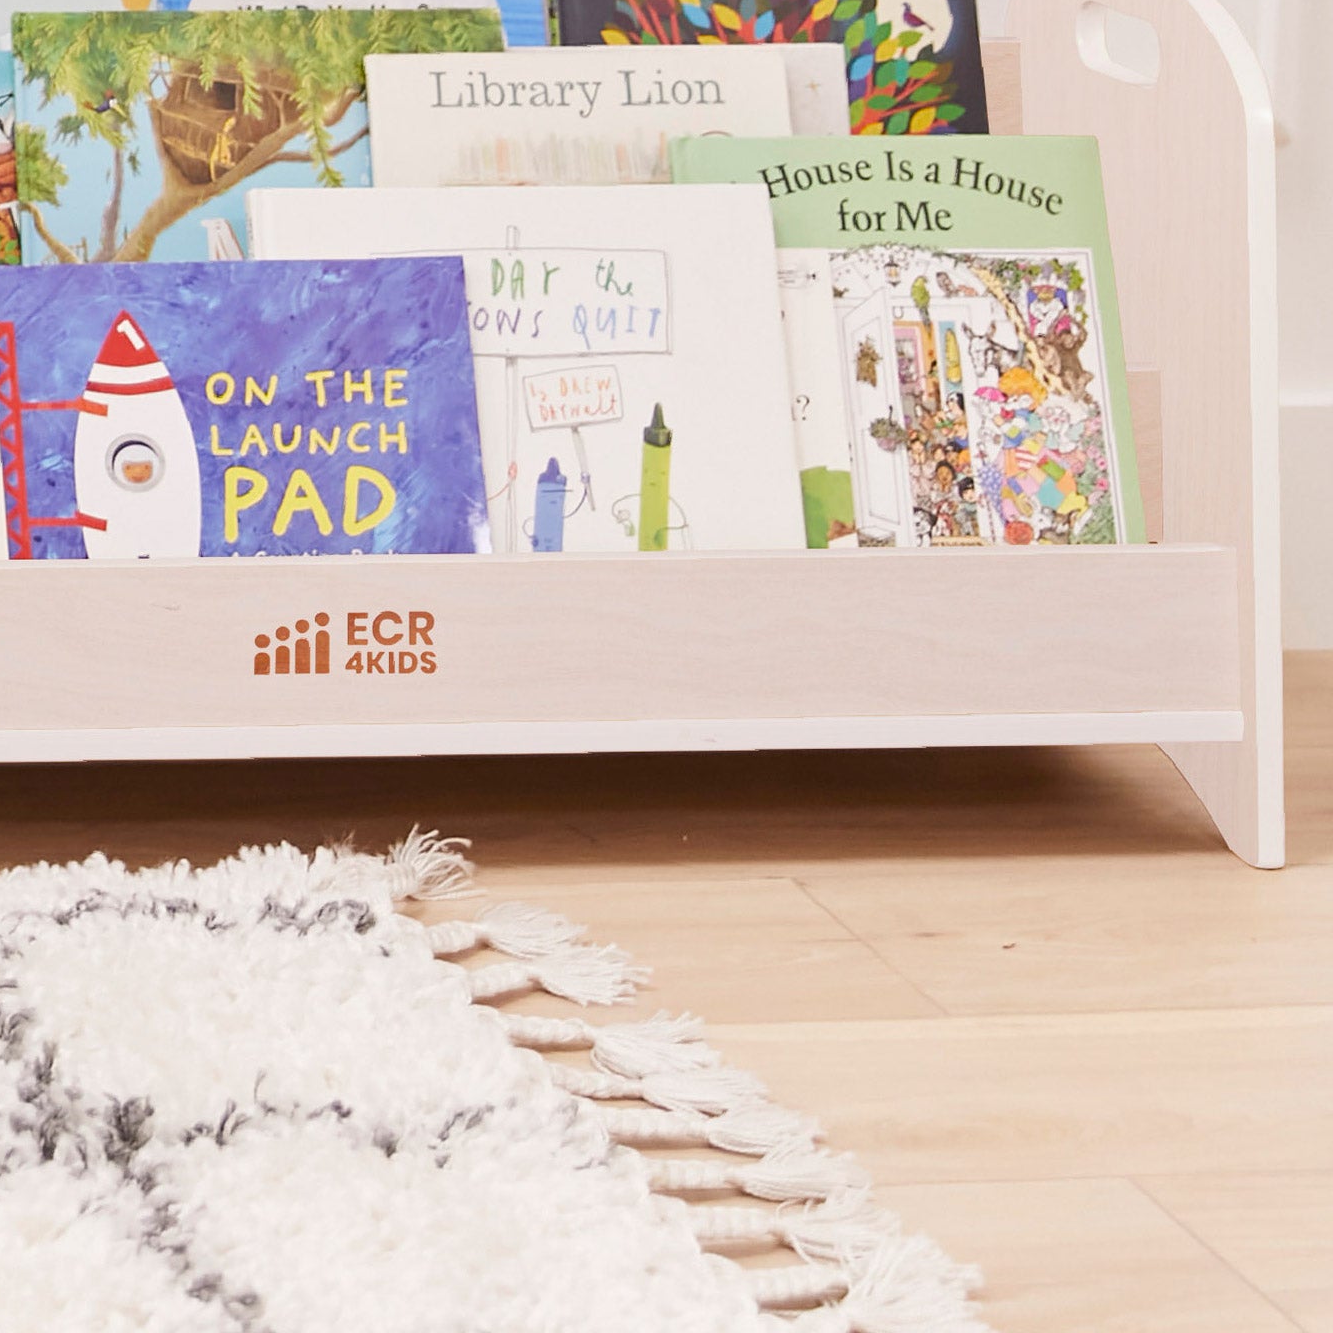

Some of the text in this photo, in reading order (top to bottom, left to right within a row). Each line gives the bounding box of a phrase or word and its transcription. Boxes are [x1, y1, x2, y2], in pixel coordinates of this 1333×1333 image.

[429, 68, 724, 118] Library Lion
[758, 150, 1064, 216] House Is a House
[837, 198, 954, 234] for Me
[491, 257, 634, 301] DAY the
[572, 302, 662, 351] QUIT
[205, 369, 409, 408] ON THE
[209, 421, 409, 458] LAUNCH
[223, 464, 398, 544] PAD
[346, 610, 435, 646] ECR
[344, 650, 438, 675] 4KIDS
